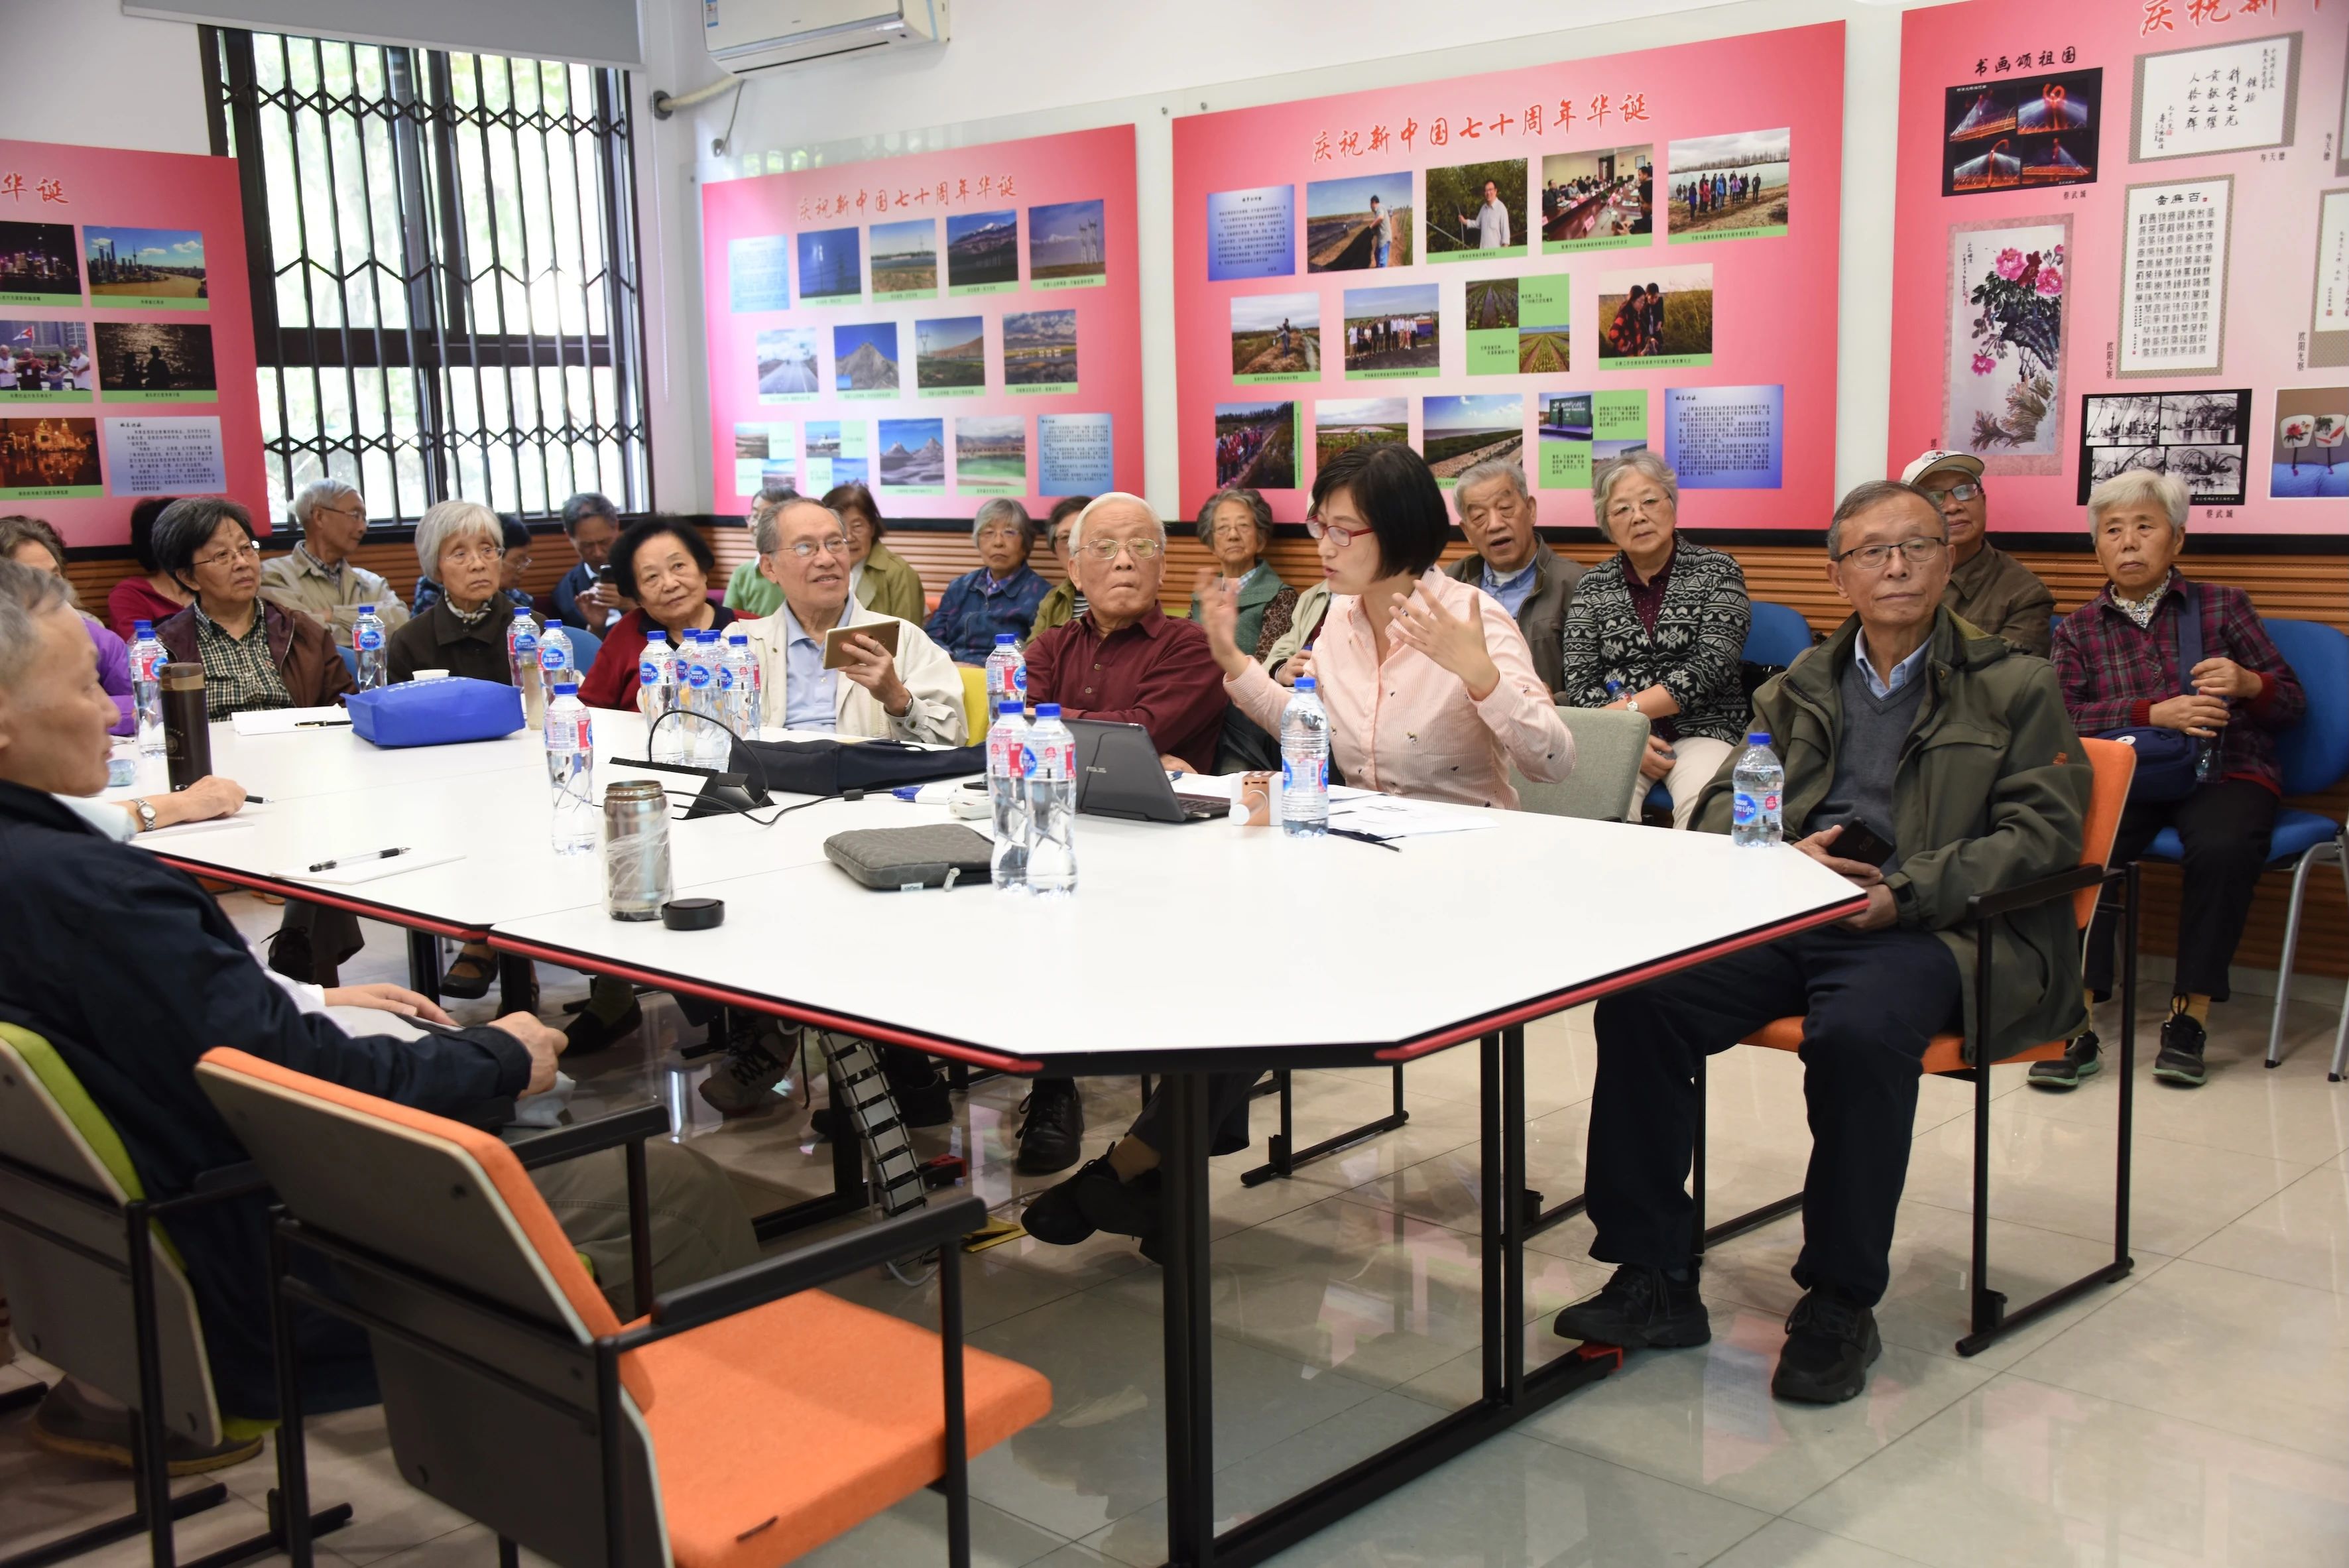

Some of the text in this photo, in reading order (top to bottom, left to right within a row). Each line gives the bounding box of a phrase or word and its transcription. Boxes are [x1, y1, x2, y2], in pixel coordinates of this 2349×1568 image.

[1974, 46, 2077, 76] 书画颂祖国
[1313, 93, 1650, 163] 庆祝新中国七十周年华诞
[1, 172, 69, 205] 华诞
[798, 174, 1018, 222] 庆祝新中国七十周年华诞
[1743, 806, 1755, 815] Life
